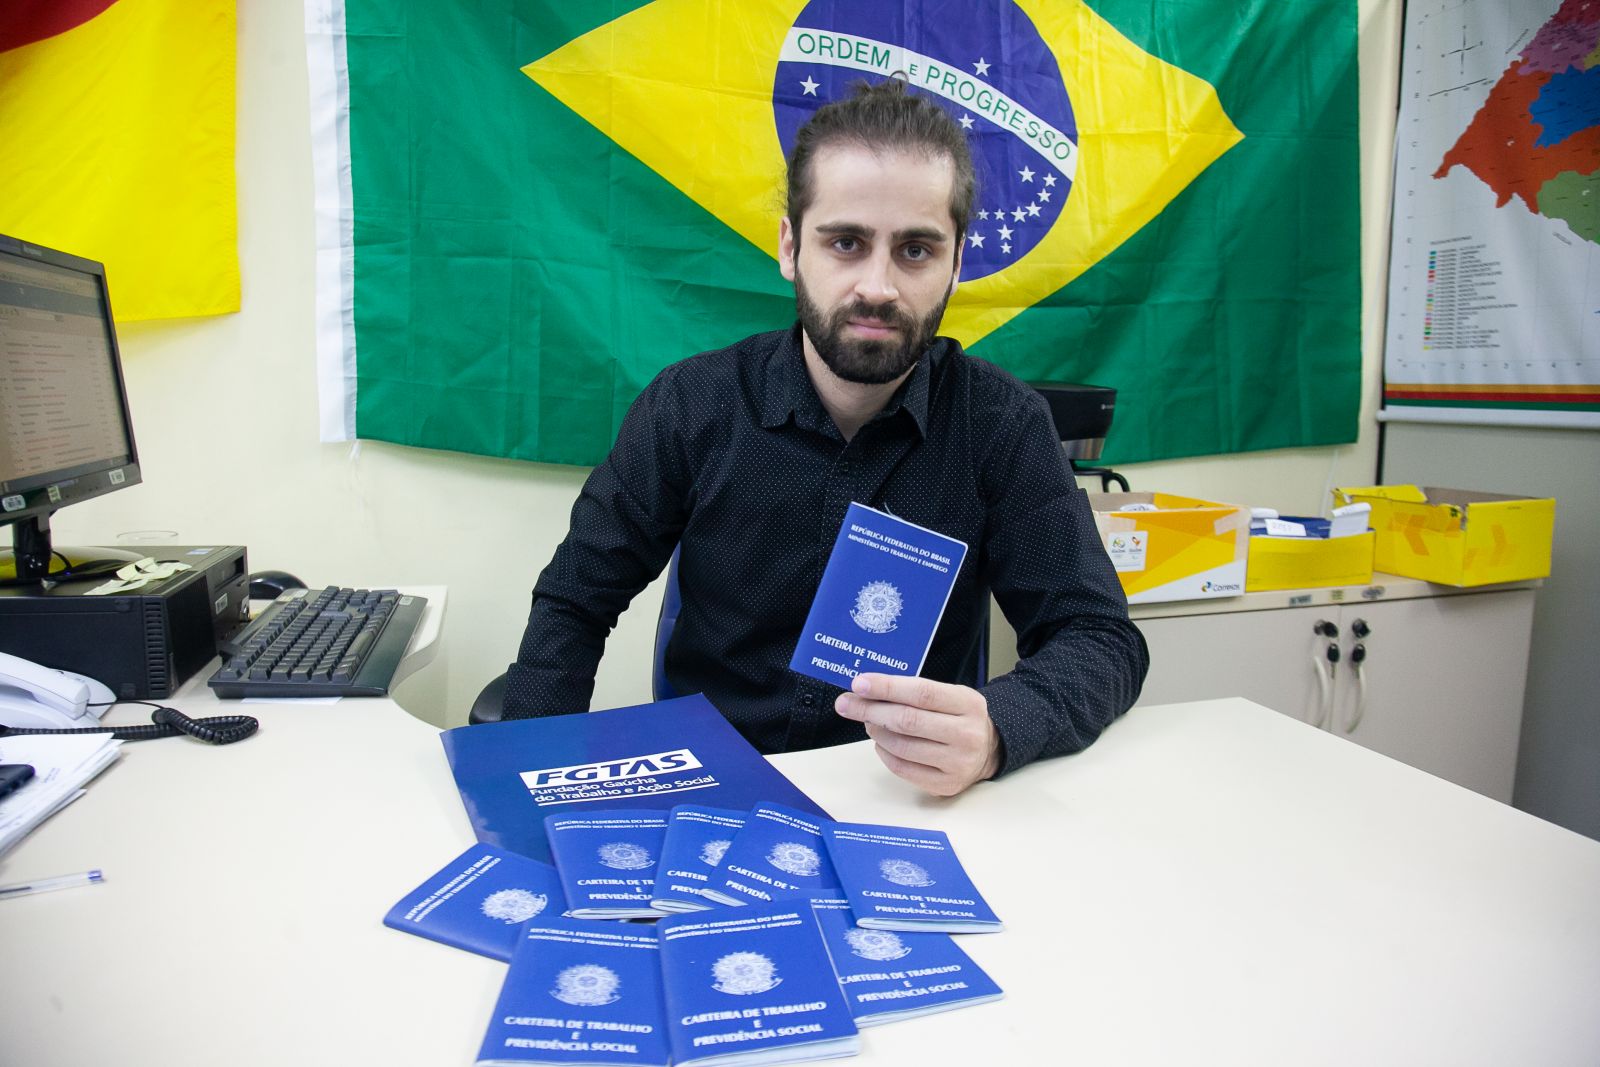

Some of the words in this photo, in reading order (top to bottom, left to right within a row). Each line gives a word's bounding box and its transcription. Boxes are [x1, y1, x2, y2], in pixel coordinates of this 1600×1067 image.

[797, 33, 891, 69] ORDEM
[925, 65, 1071, 161] PROGRESSO
[848, 533, 880, 549] MINISTÉRIO
[880, 544, 889, 552] DO
[890, 547, 917, 563] TRABALHO
[922, 559, 948, 574] EMPREGO
[851, 523, 884, 541] REPÚBLICA
[884, 535, 919, 554] FEDERATIVA
[919, 547, 930, 557] DO
[930, 550, 950, 565] BRASIL
[814, 632, 852, 653] CARTEIRA
[854, 645, 866, 657] DE
[867, 649, 908, 671] TRABALHO
[811, 656, 860, 679] PREVIDÊNCI
[854, 659, 861, 667] E
[535, 753, 688, 786] FGTAS
[530, 783, 600, 796] Fundação
[603, 776, 656, 789] Gaúcha
[534, 792, 555, 803] do
[558, 787, 622, 800] Trabalho
[638, 781, 673, 793] Ação
[675, 775, 715, 787] Social
[577, 878, 625, 886] CARTEIRA
[667, 870, 709, 881] CARTEIR
[728, 865, 772, 884] CARTEIRA
[773, 880, 788, 890] DE
[589, 892, 653, 900] PREVIDÊNCI
[725, 880, 771, 901] PREVIDÊN
[862, 890, 909, 900] CARTEIRA
[924, 896, 975, 906] TRABALHO
[875, 905, 940, 915] PREVIDÊNCIA
[940, 910, 977, 918] SOCIAL
[839, 973, 890, 984] CARTEIRA
[889, 971, 906, 979] DE
[906, 964, 961, 978] TRABALHO
[903, 980, 912, 988] E
[856, 988, 929, 1003] PREVIDÊNCIA
[928, 981, 969, 993] SOCIAL
[681, 1010, 742, 1026] CARTEIRA
[742, 1008, 761, 1018] DE
[761, 1001, 827, 1016] TRABALHO
[753, 1019, 762, 1028] E
[503, 1016, 565, 1028] CARTEIRA
[566, 1019, 585, 1029] DE
[586, 1021, 653, 1034] TRABALHO
[693, 1029, 777, 1047] PREVIDÊNCIA
[777, 1023, 824, 1037] SOCIAL
[504, 1037, 590, 1051] PREVIDÊNCIA
[590, 1042, 639, 1053] SOCIAL
[571, 1031, 581, 1040] E
